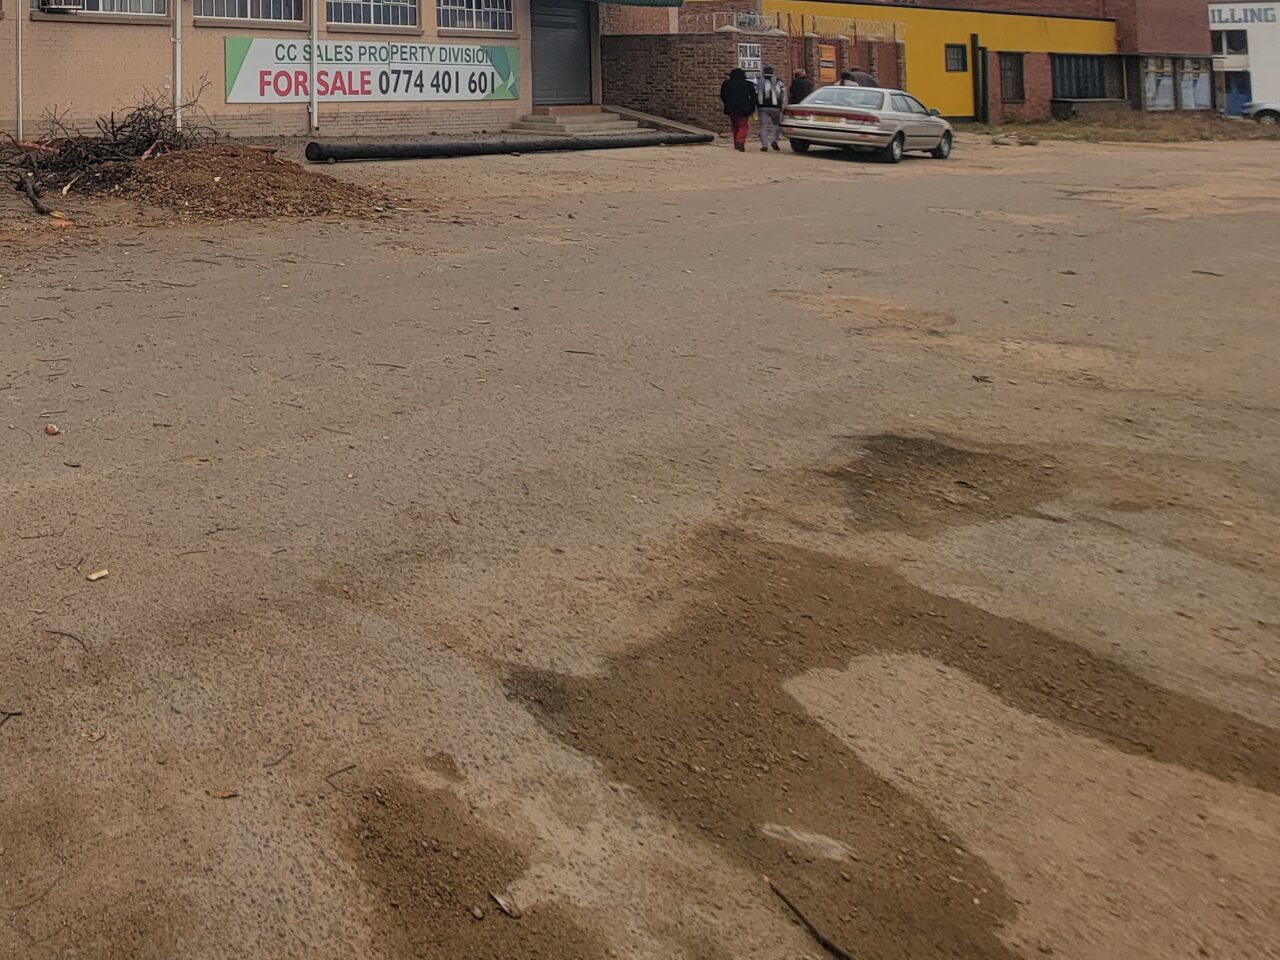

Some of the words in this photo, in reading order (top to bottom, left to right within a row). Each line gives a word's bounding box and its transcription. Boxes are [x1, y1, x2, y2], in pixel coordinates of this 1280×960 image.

[275, 44, 297, 61] CC
[303, 44, 353, 62] SALES
[358, 44, 435, 63] PROPERTY
[440, 46, 493, 64] DIVISION
[259, 70, 309, 96] FOR
[316, 70, 372, 96] SALE
[379, 69, 424, 95] 0774
[430, 70, 459, 93] 401
[468, 71, 495, 94] 601
